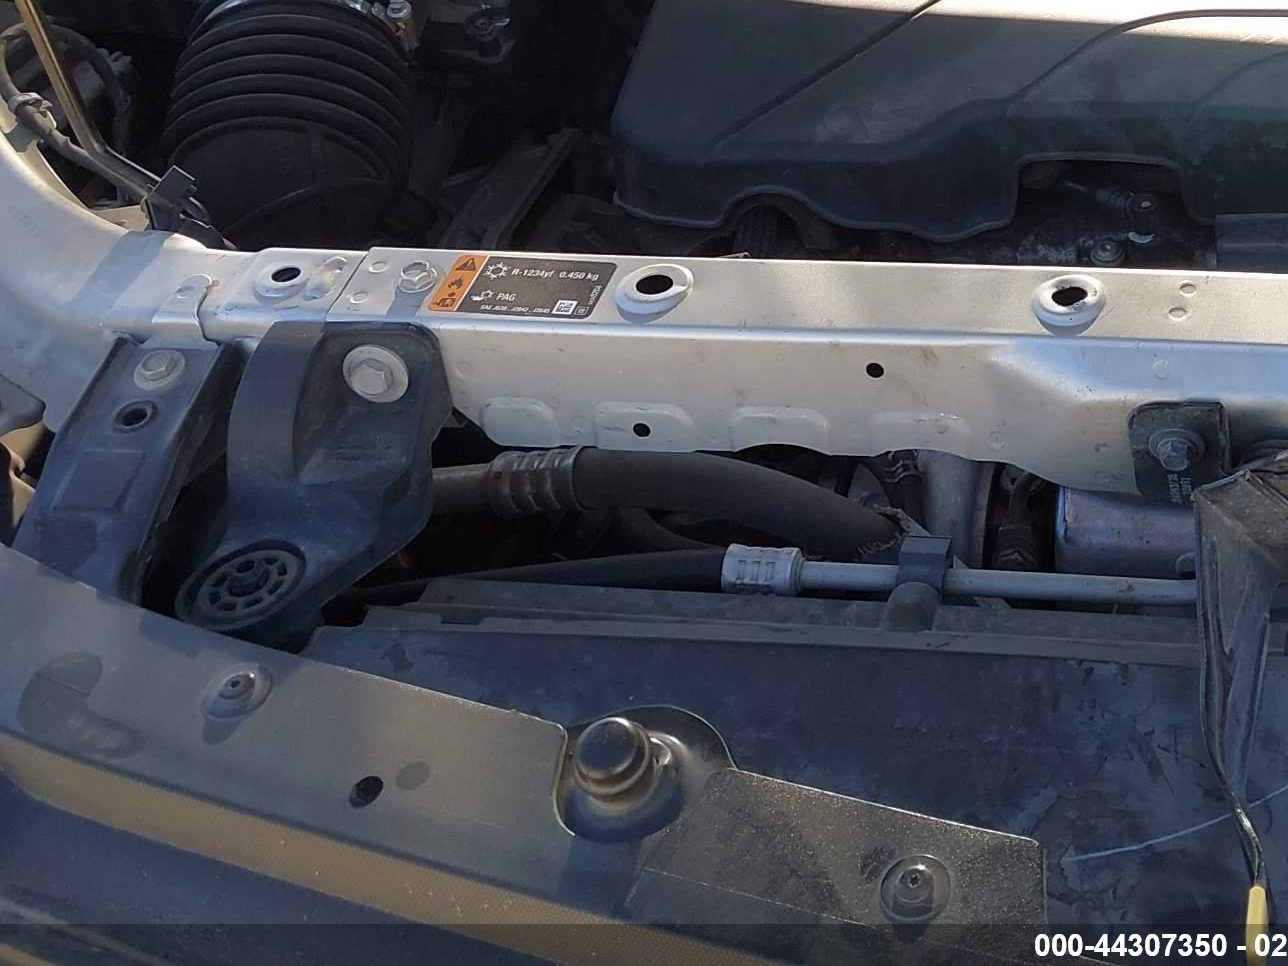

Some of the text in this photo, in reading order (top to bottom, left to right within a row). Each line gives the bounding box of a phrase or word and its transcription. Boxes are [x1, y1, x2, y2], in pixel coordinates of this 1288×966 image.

[511, 268, 599, 282] R-1234yf 0.450 kg
[496, 292, 517, 302] PAG
